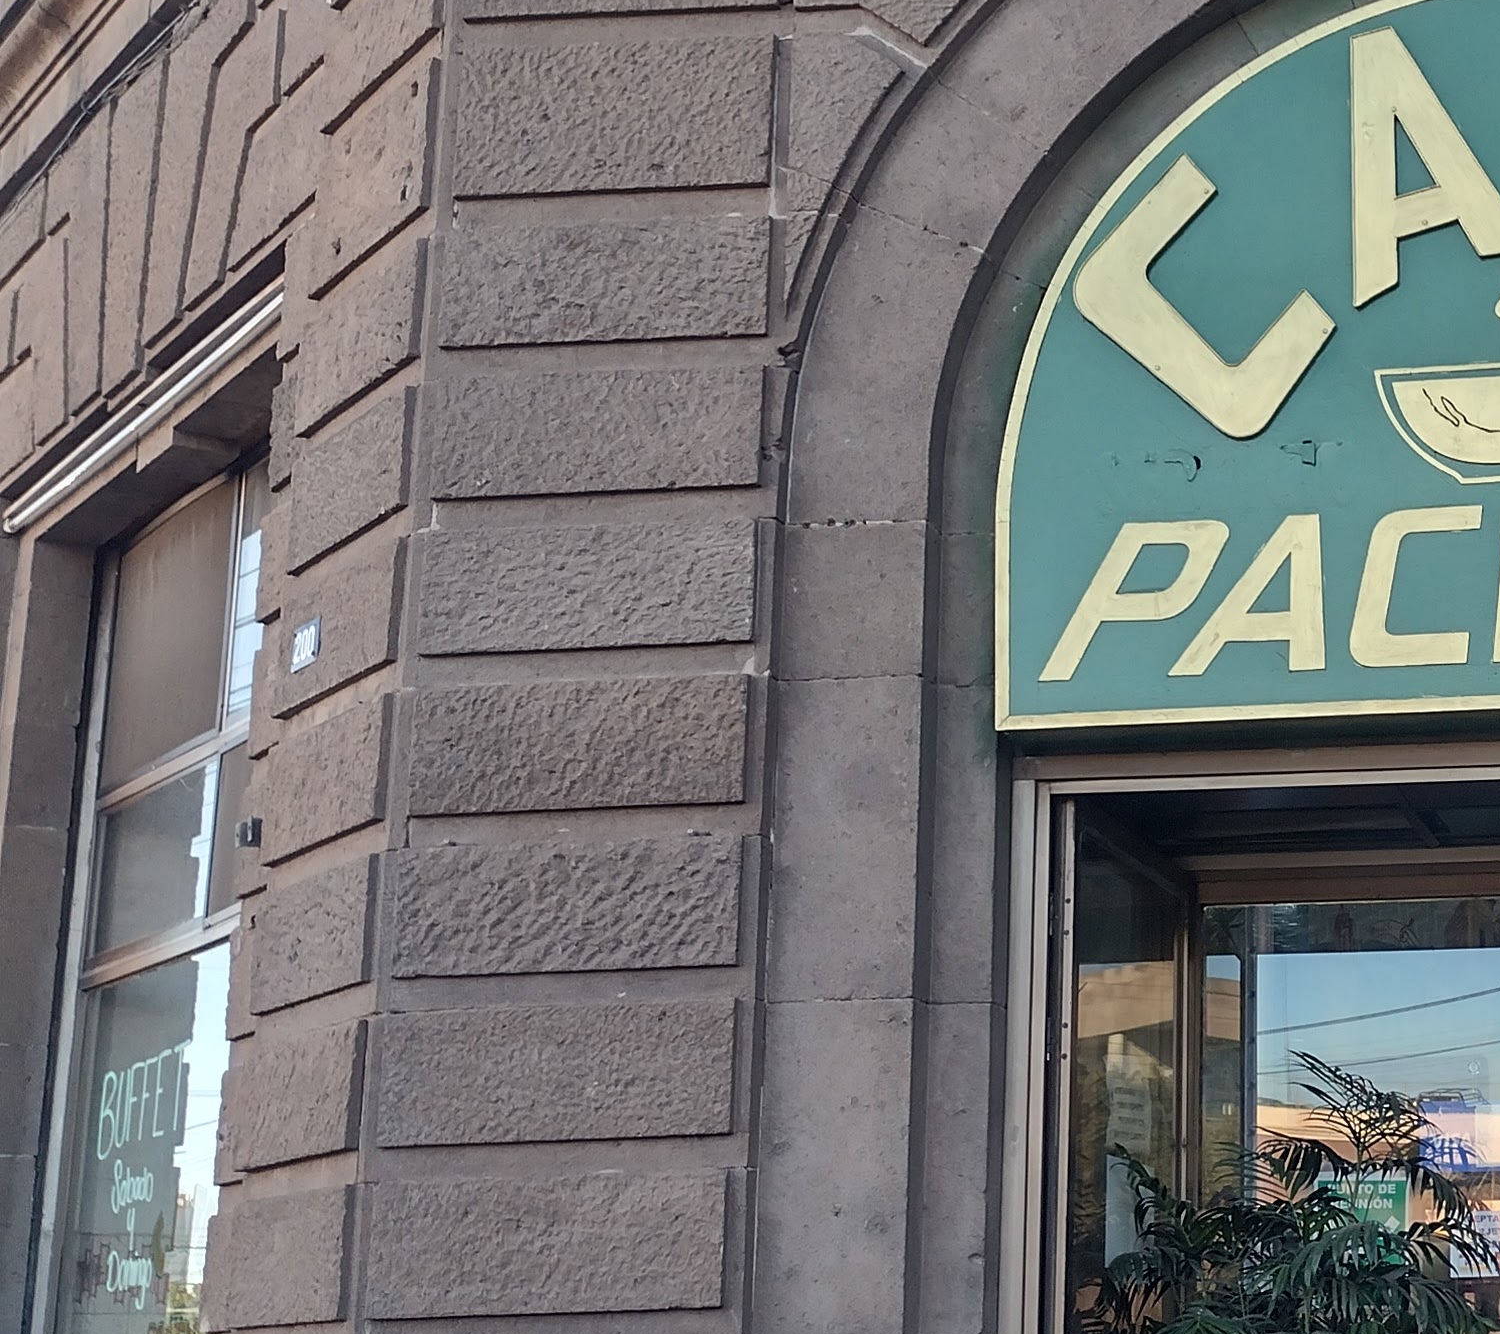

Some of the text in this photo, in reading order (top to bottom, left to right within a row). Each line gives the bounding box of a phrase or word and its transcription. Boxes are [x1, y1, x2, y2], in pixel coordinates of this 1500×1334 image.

[292, 625, 316, 665] 200
[97, 1039, 191, 1160] BUFFET
[1379, 1184, 1396, 1194] DE
